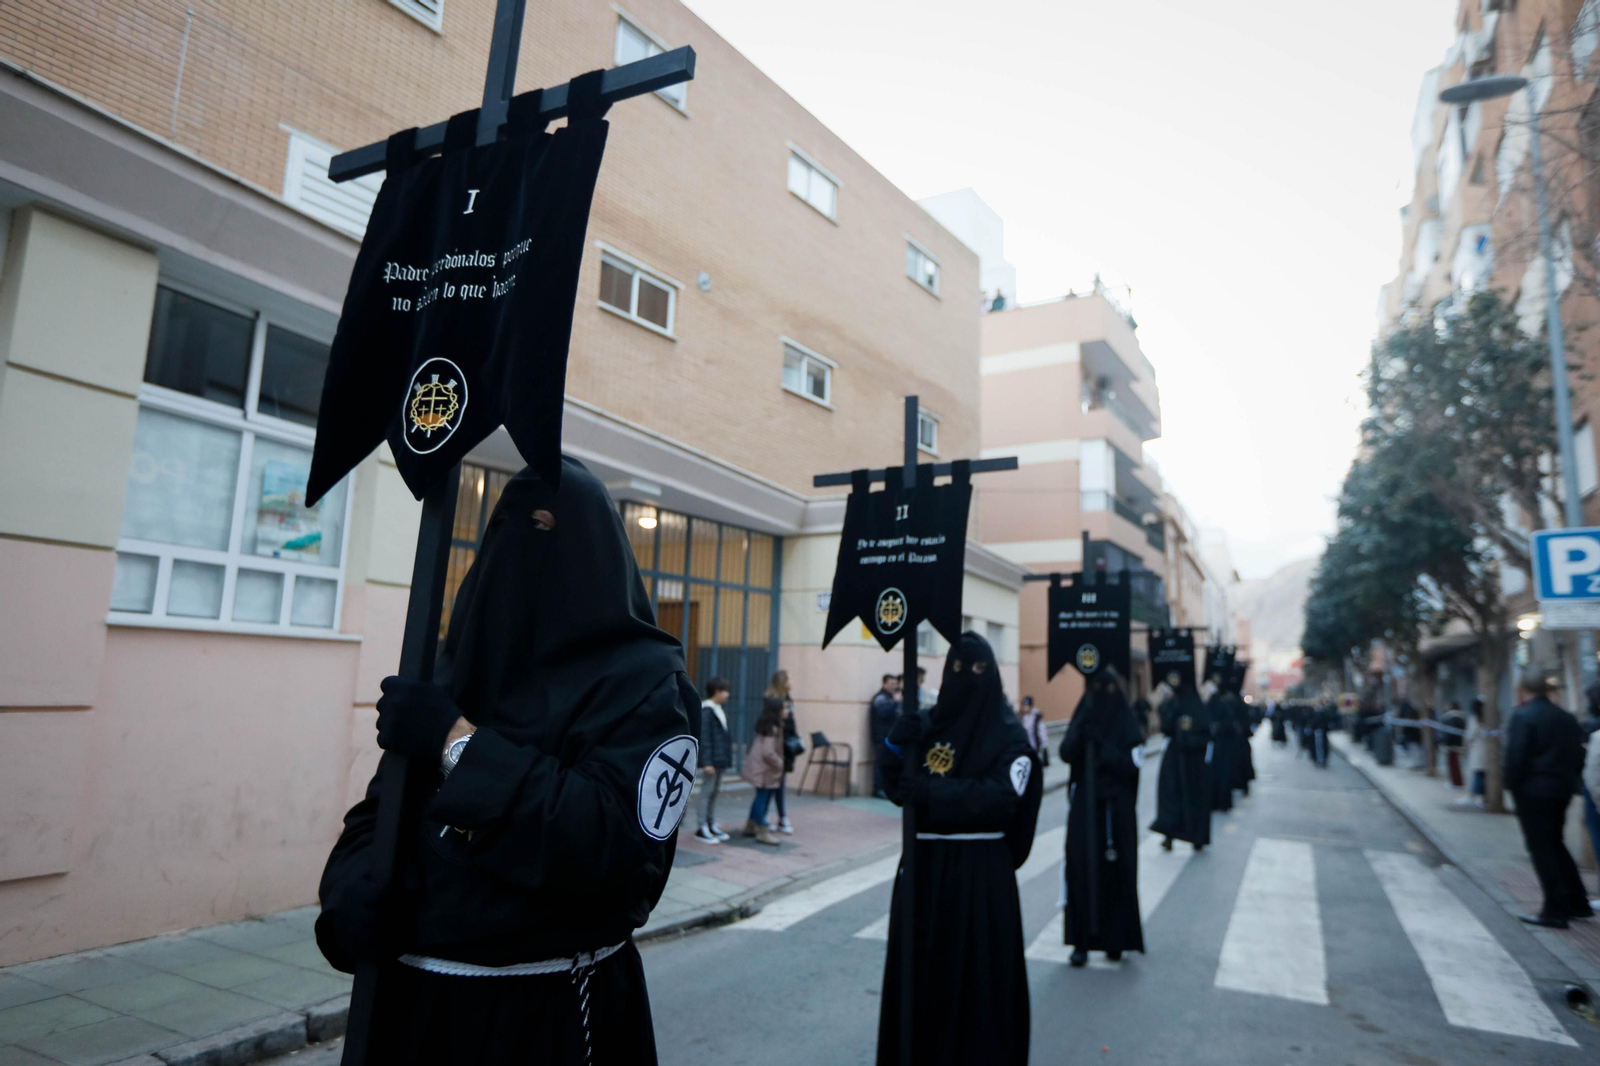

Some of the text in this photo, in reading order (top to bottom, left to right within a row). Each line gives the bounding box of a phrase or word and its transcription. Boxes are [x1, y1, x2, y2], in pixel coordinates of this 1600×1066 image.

[383, 261, 429, 283] Padre
[431, 248, 497, 275] erdónalos
[392, 297, 411, 312] no
[443, 282, 455, 298] lo
[460, 284, 486, 300] que
[895, 505, 909, 521] II
[1547, 535, 1600, 595] P
